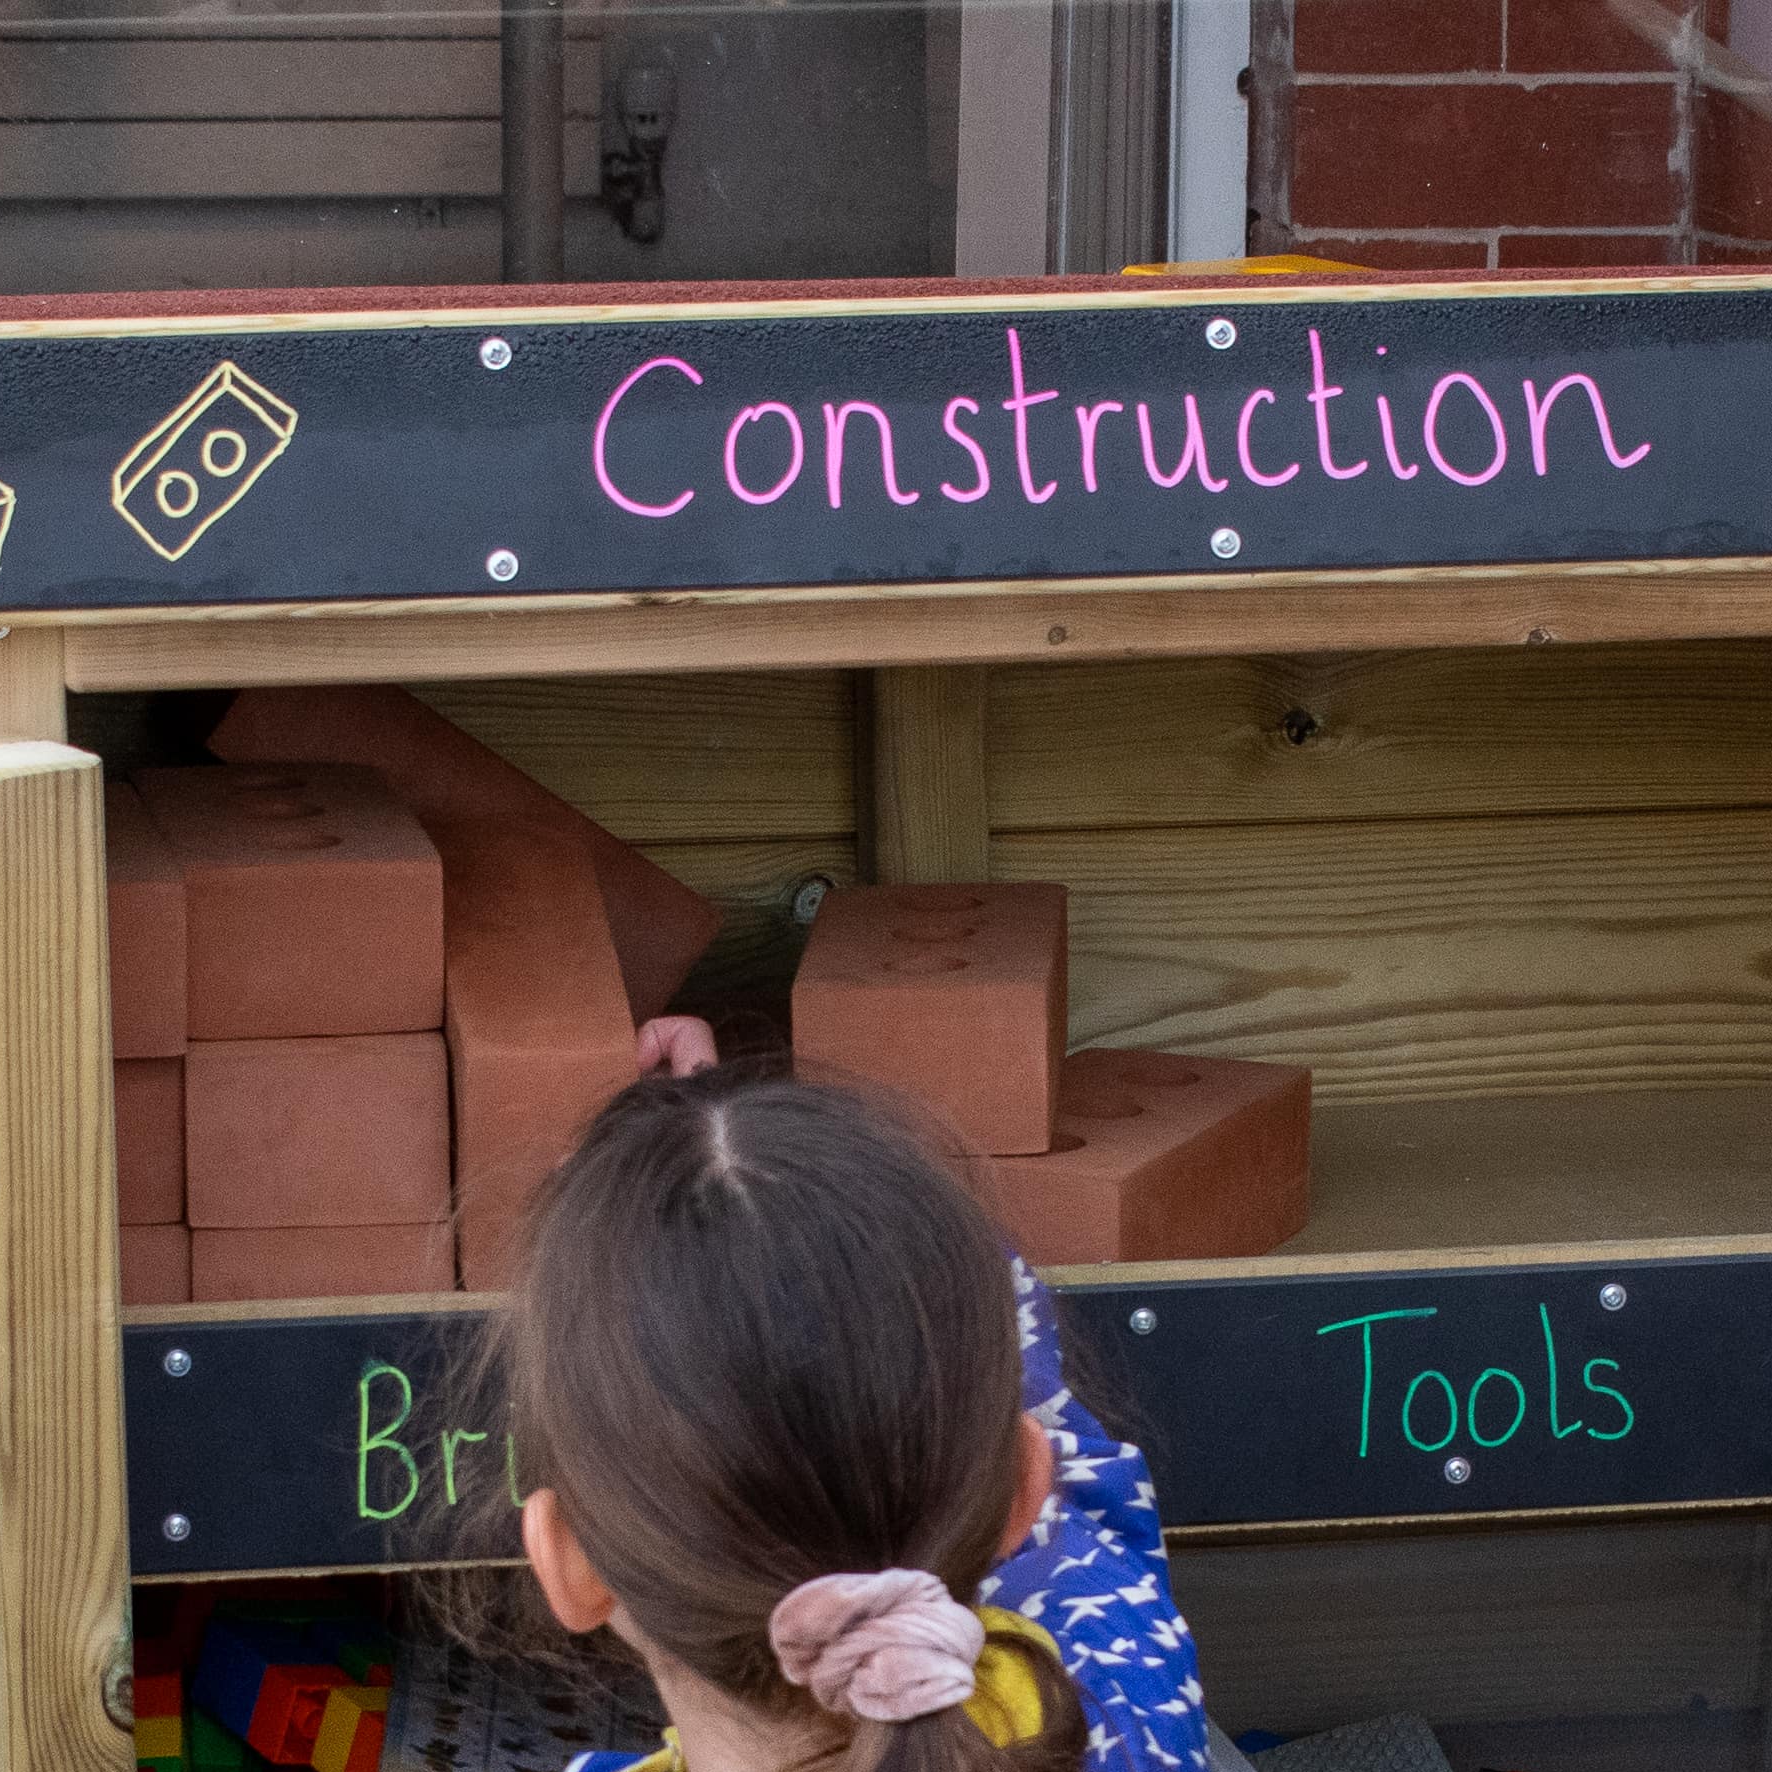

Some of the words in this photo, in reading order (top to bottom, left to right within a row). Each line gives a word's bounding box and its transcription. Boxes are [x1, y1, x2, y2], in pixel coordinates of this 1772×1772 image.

[592, 327, 1653, 520] Construction
[356, 1362, 527, 1521] Bri
[1315, 1300, 1637, 1459] Tools
